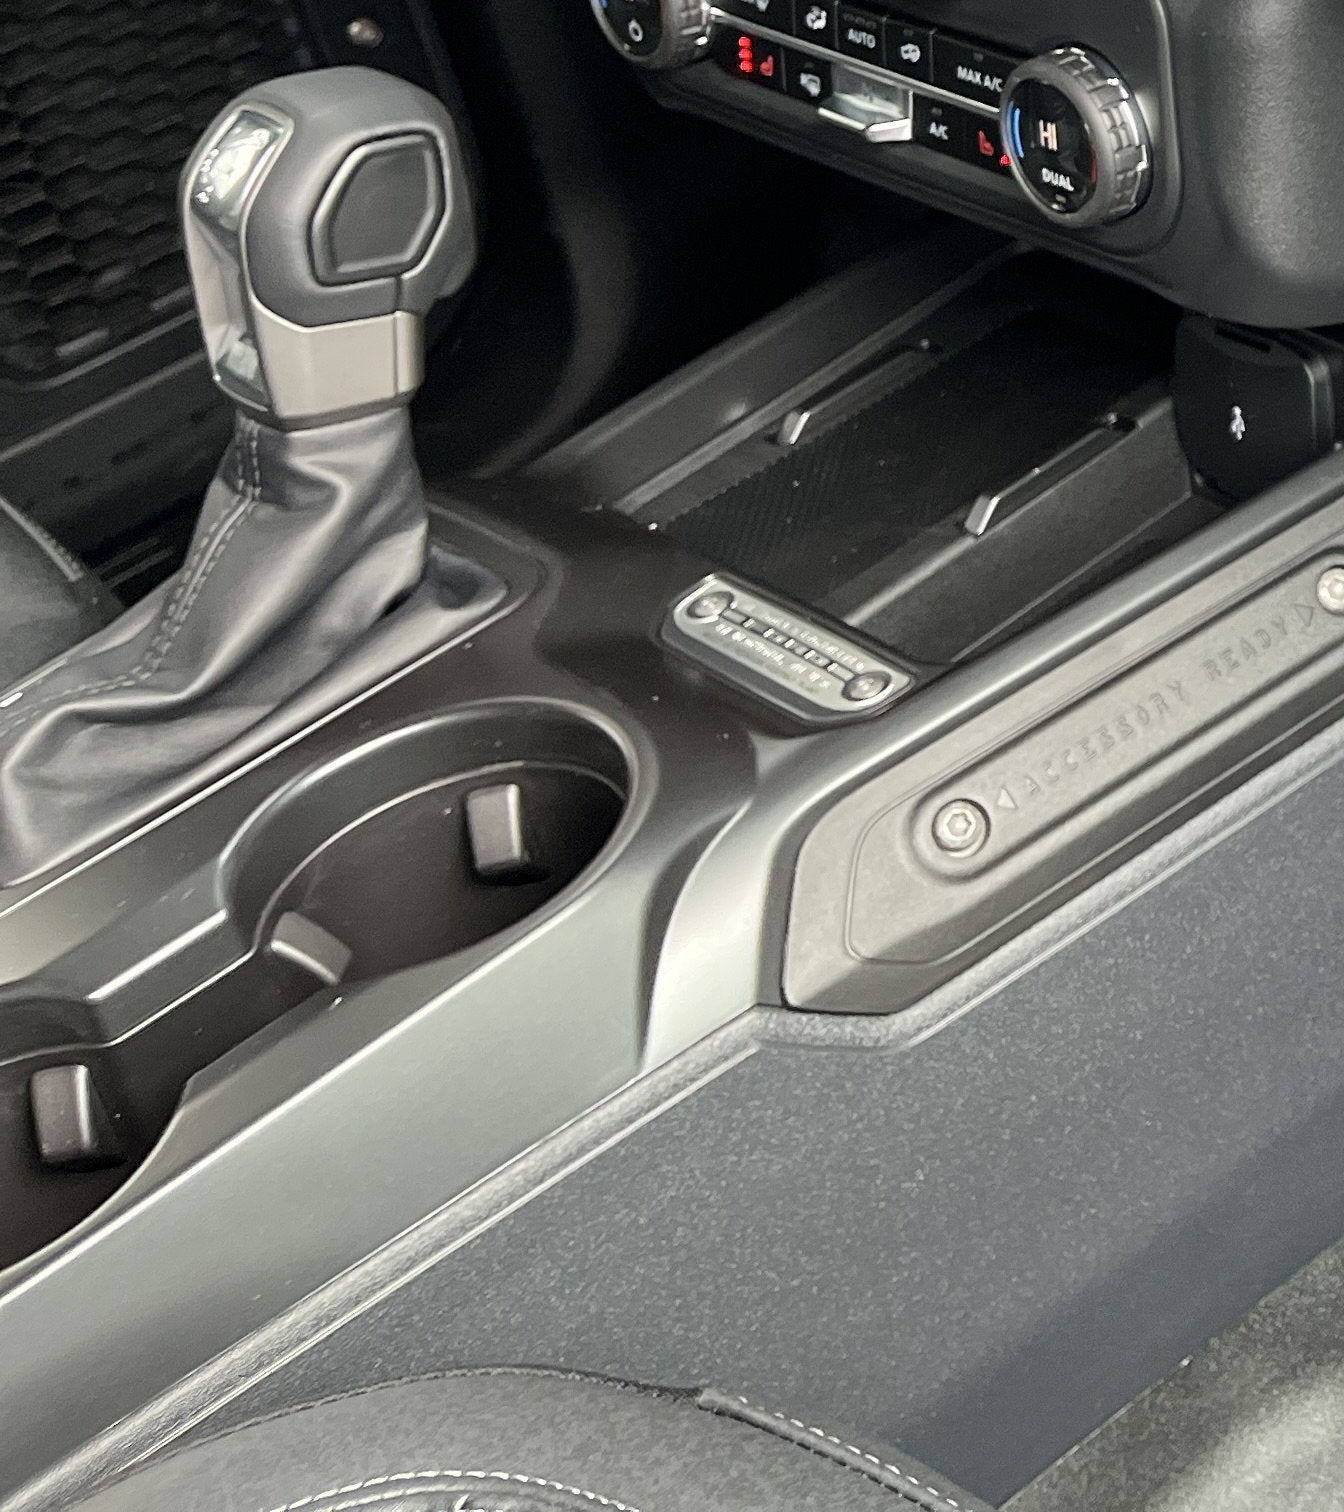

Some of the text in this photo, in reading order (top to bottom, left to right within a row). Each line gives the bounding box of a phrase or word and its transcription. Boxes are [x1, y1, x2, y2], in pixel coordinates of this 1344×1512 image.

[848, 29, 876, 49] AUTO
[957, 65, 982, 86] MAX
[929, 121, 949, 142] A/C
[1038, 120, 1059, 151] HI
[1042, 167, 1075, 192] DUAL
[1025, 618, 1290, 796] ACCESSORY READY
